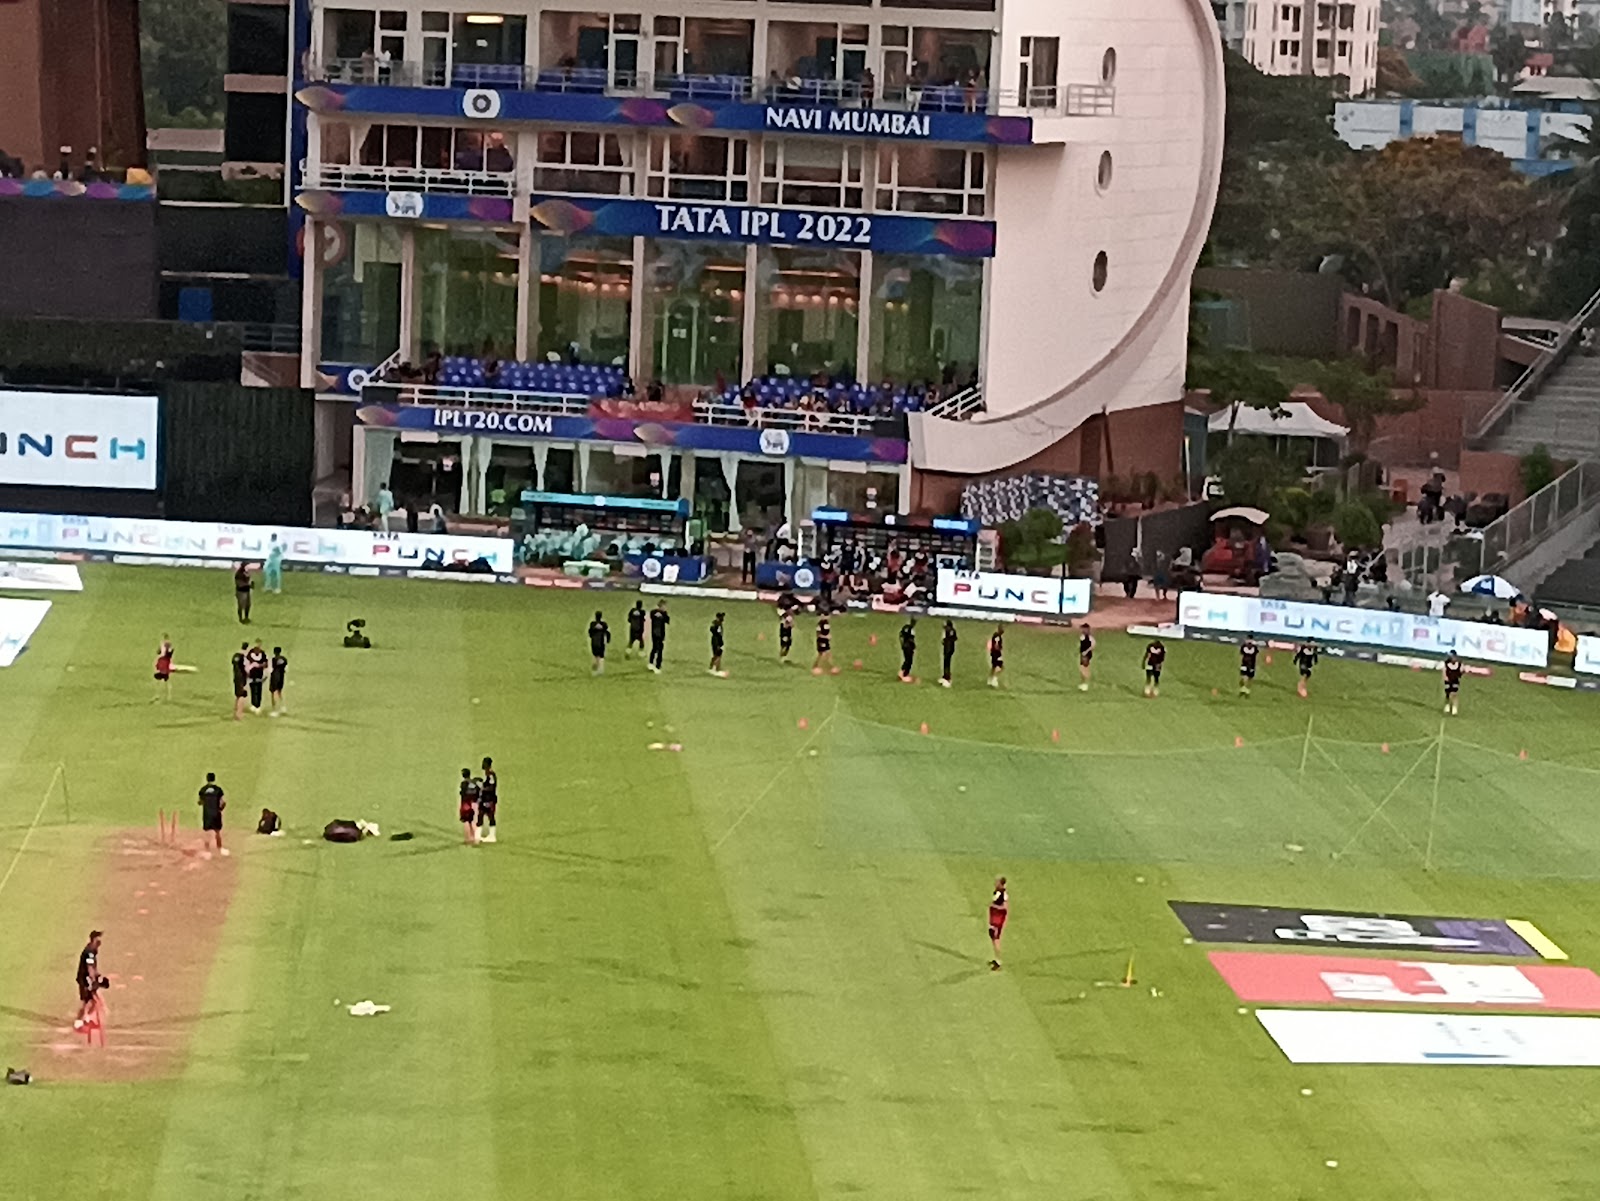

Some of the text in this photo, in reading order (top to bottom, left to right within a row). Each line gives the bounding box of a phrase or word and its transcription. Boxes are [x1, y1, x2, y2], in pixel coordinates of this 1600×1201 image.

[766, 106, 930, 136] NAVI MUMBAI
[655, 204, 872, 243] TATA IPL 2022
[433, 408, 553, 434] IPLT20.COM
[0, 432, 146, 460] NCH
[953, 582, 1077, 605] PUNCH
